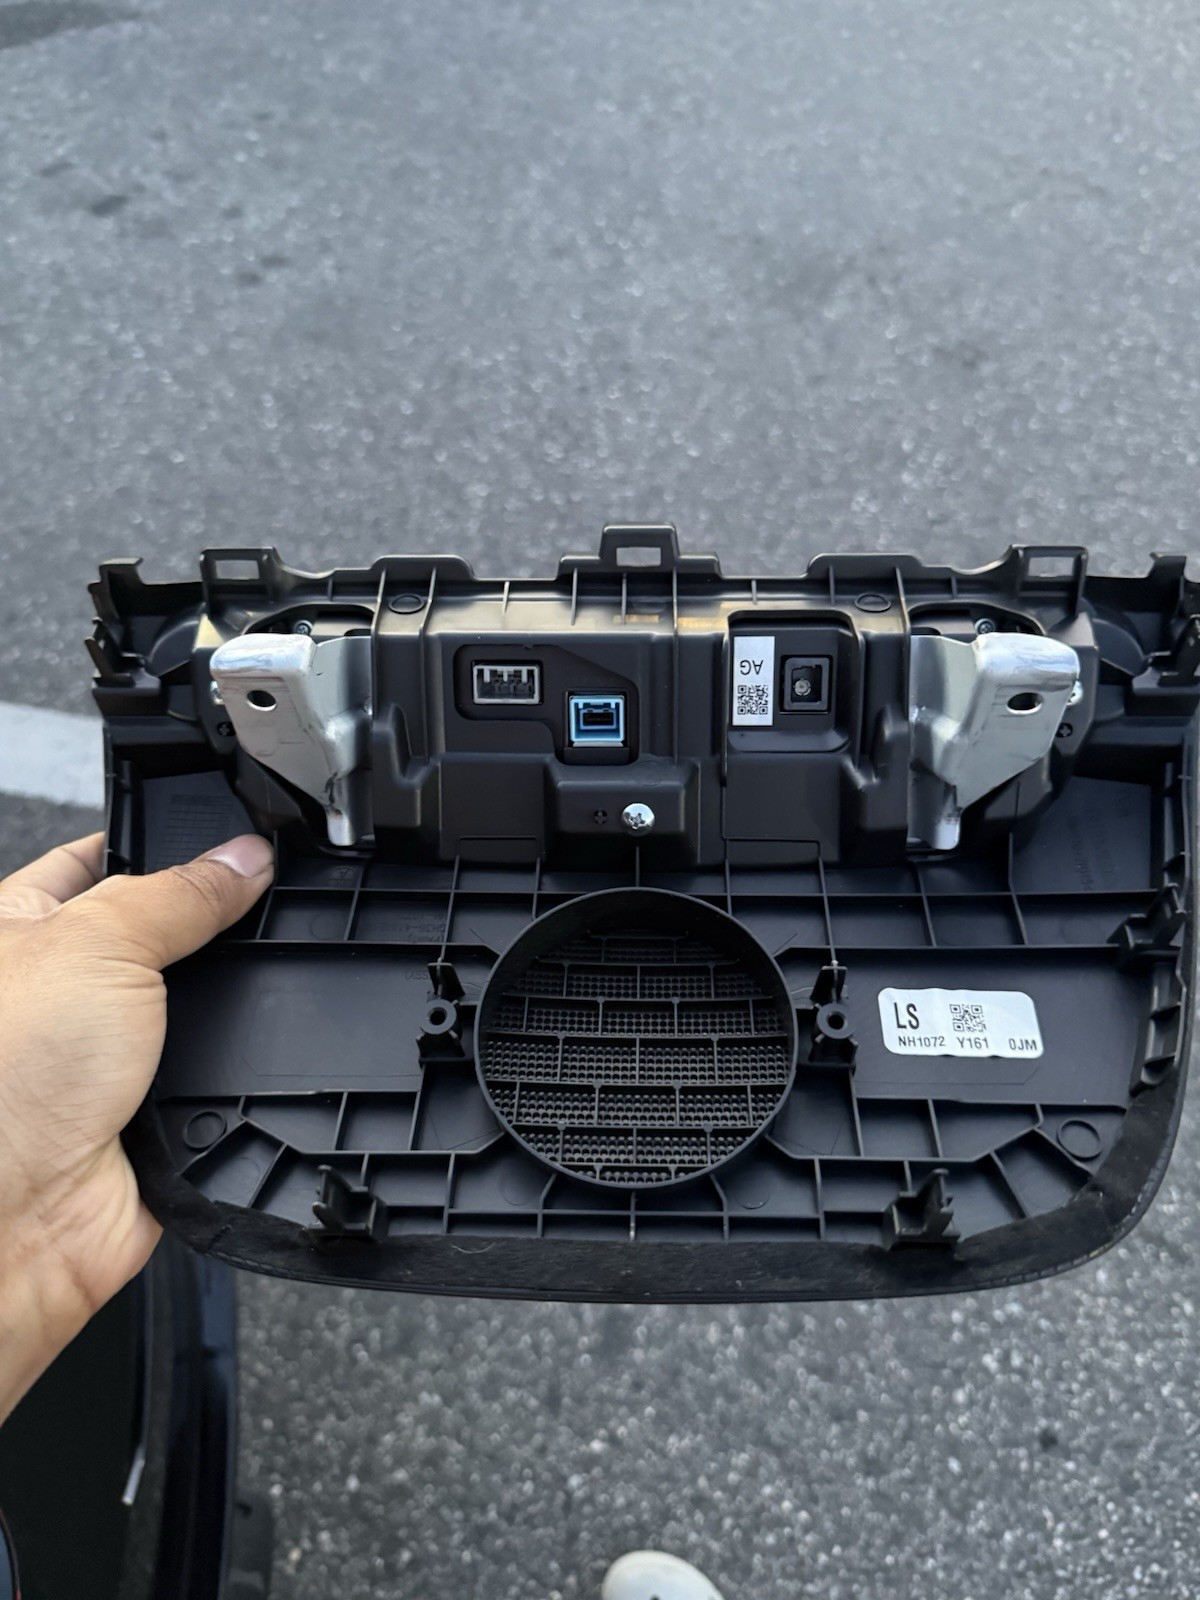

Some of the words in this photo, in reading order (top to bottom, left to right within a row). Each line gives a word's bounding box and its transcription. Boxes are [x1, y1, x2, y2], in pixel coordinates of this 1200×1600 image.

[740, 659, 764, 676] AG
[894, 1002, 920, 1030] LS
[898, 1035, 946, 1048] NH1072
[956, 1036, 990, 1050] Y161
